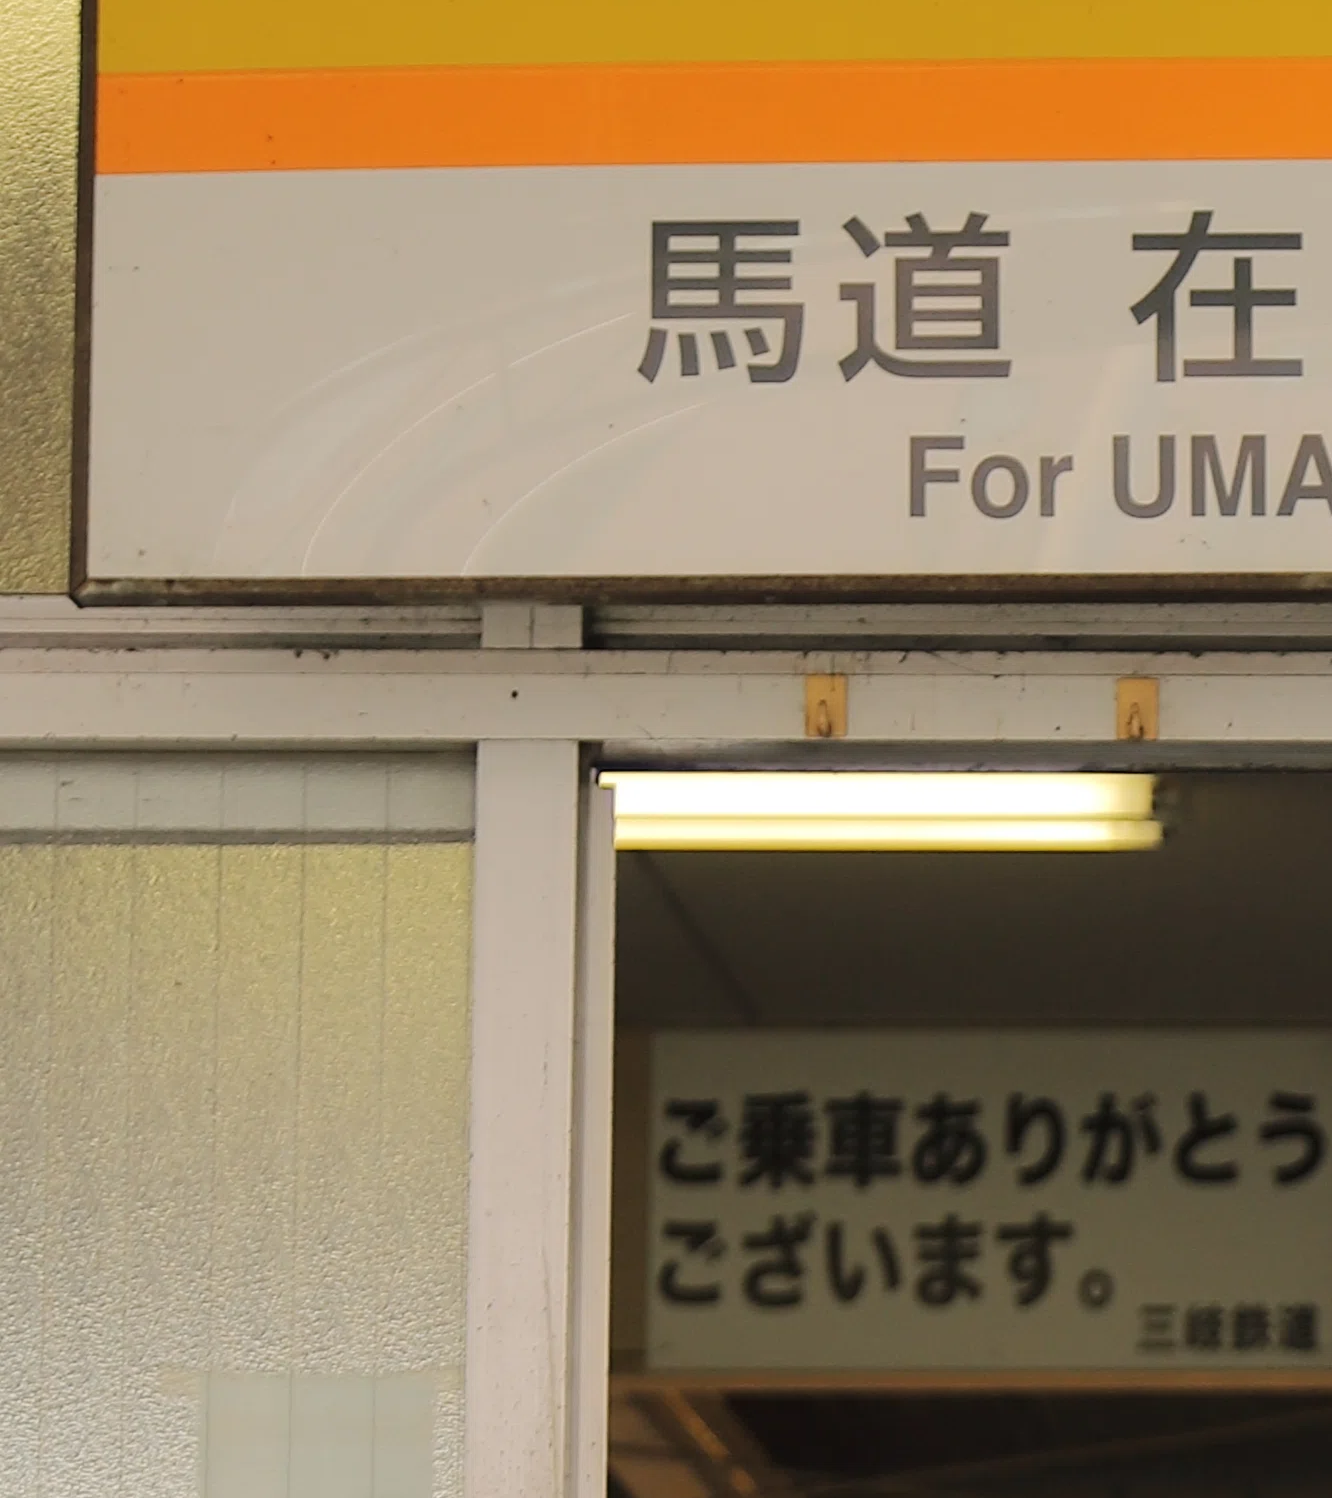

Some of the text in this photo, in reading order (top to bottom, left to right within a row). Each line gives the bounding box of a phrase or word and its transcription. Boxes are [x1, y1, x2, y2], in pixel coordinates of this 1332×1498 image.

[636, 214, 1013, 384] 馬道
[906, 435, 1074, 520] For
[658, 1090, 1328, 1190] ご乗車ありがとう
[656, 1210, 1116, 1310] ございます。
